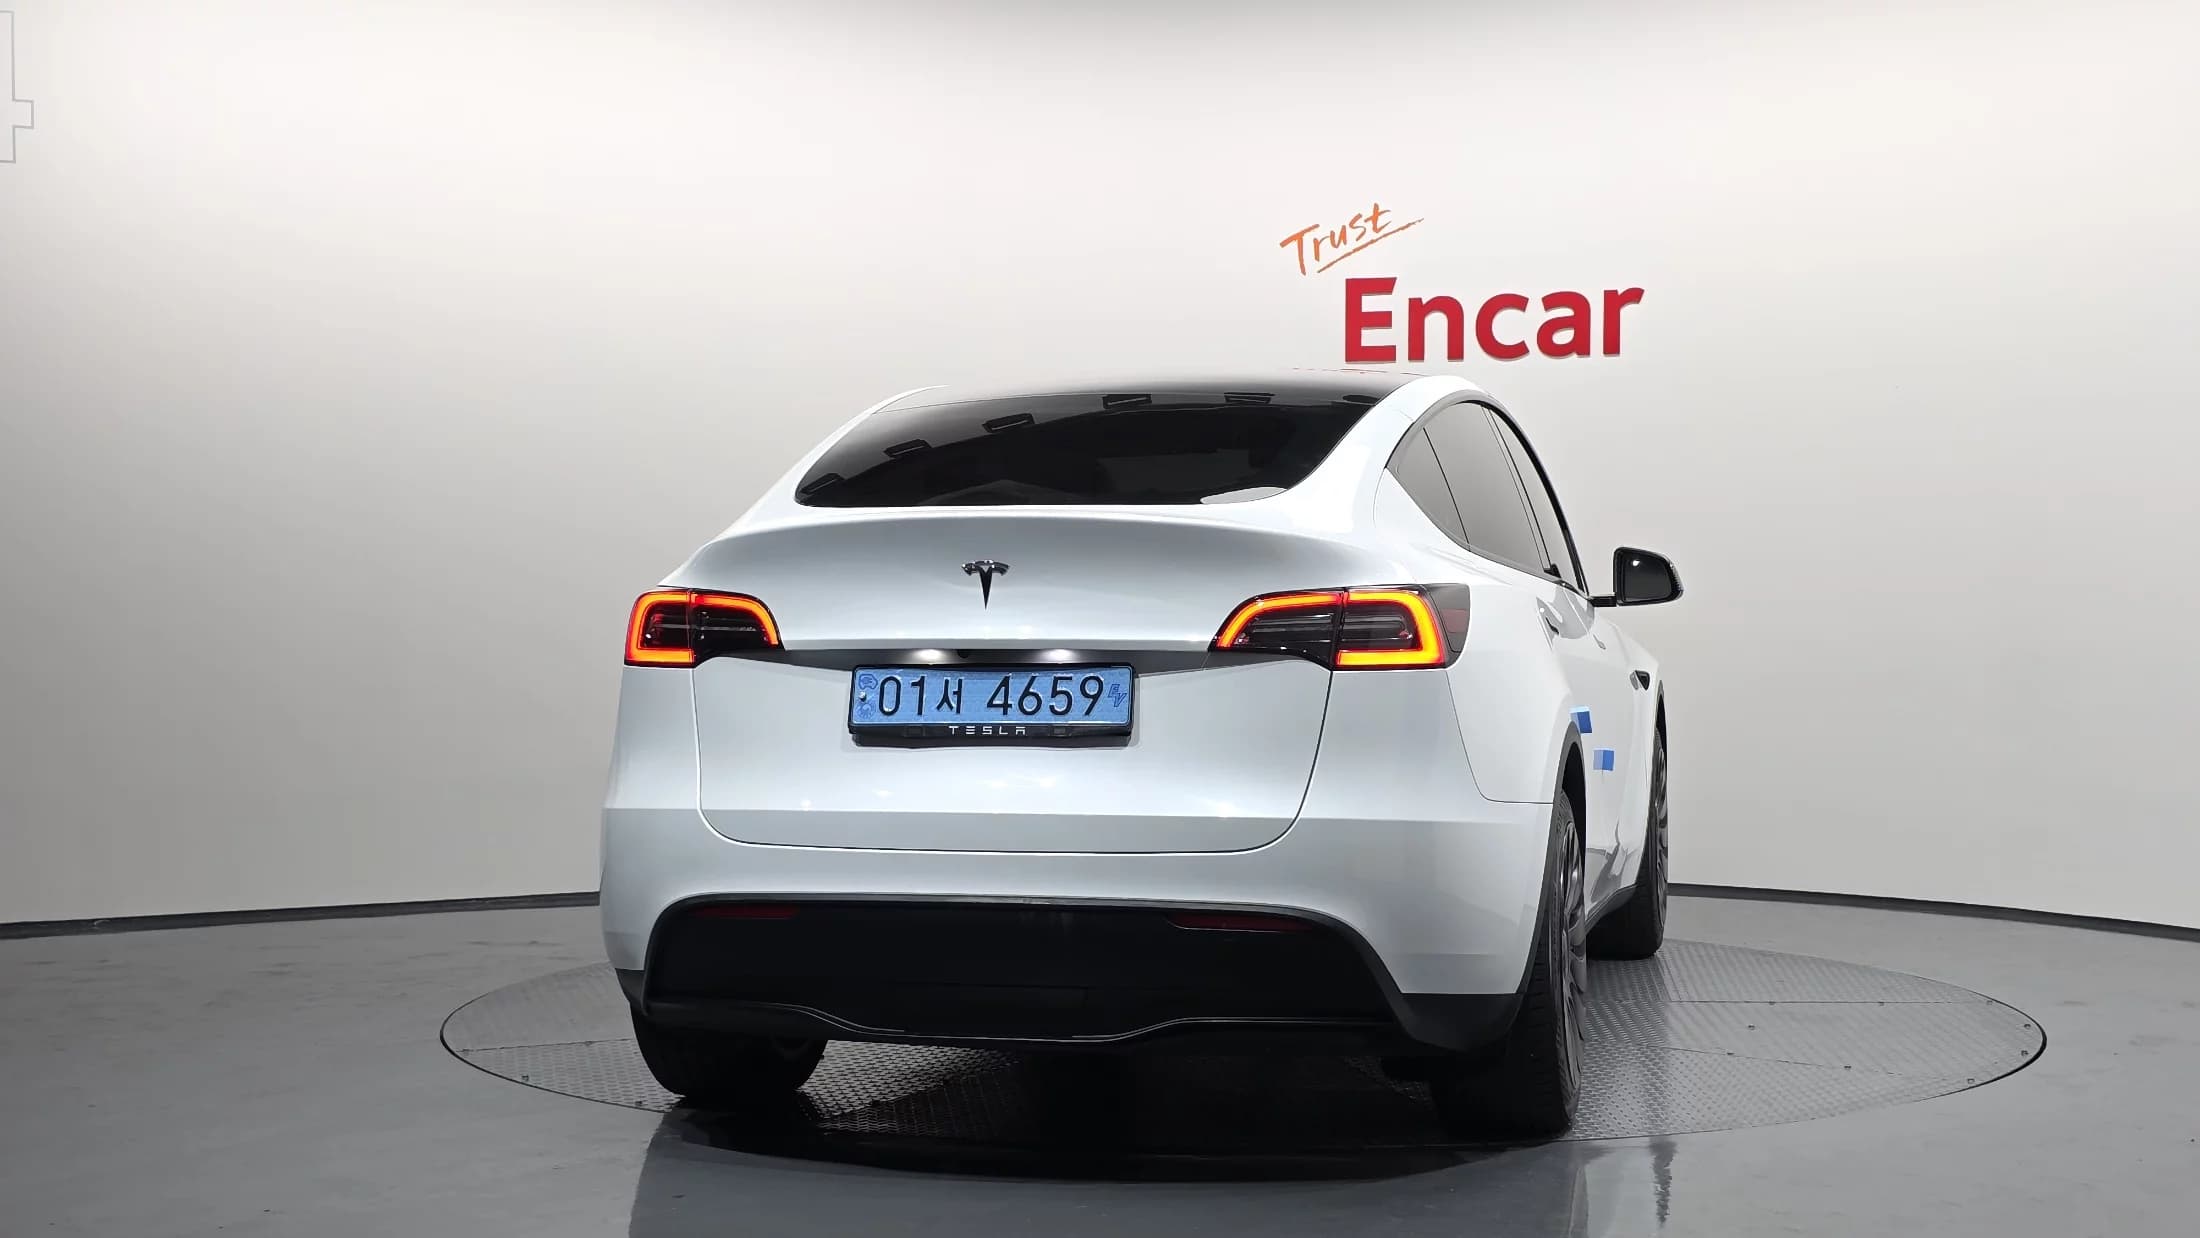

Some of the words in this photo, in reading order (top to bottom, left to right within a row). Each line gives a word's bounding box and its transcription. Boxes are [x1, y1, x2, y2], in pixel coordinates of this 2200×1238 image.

[1280, 202, 1391, 276] Trust
[1345, 277, 1645, 363] Encar
[878, 675, 963, 716] 01서
[986, 674, 1104, 716] 4659
[949, 726, 1026, 735] TESLA
